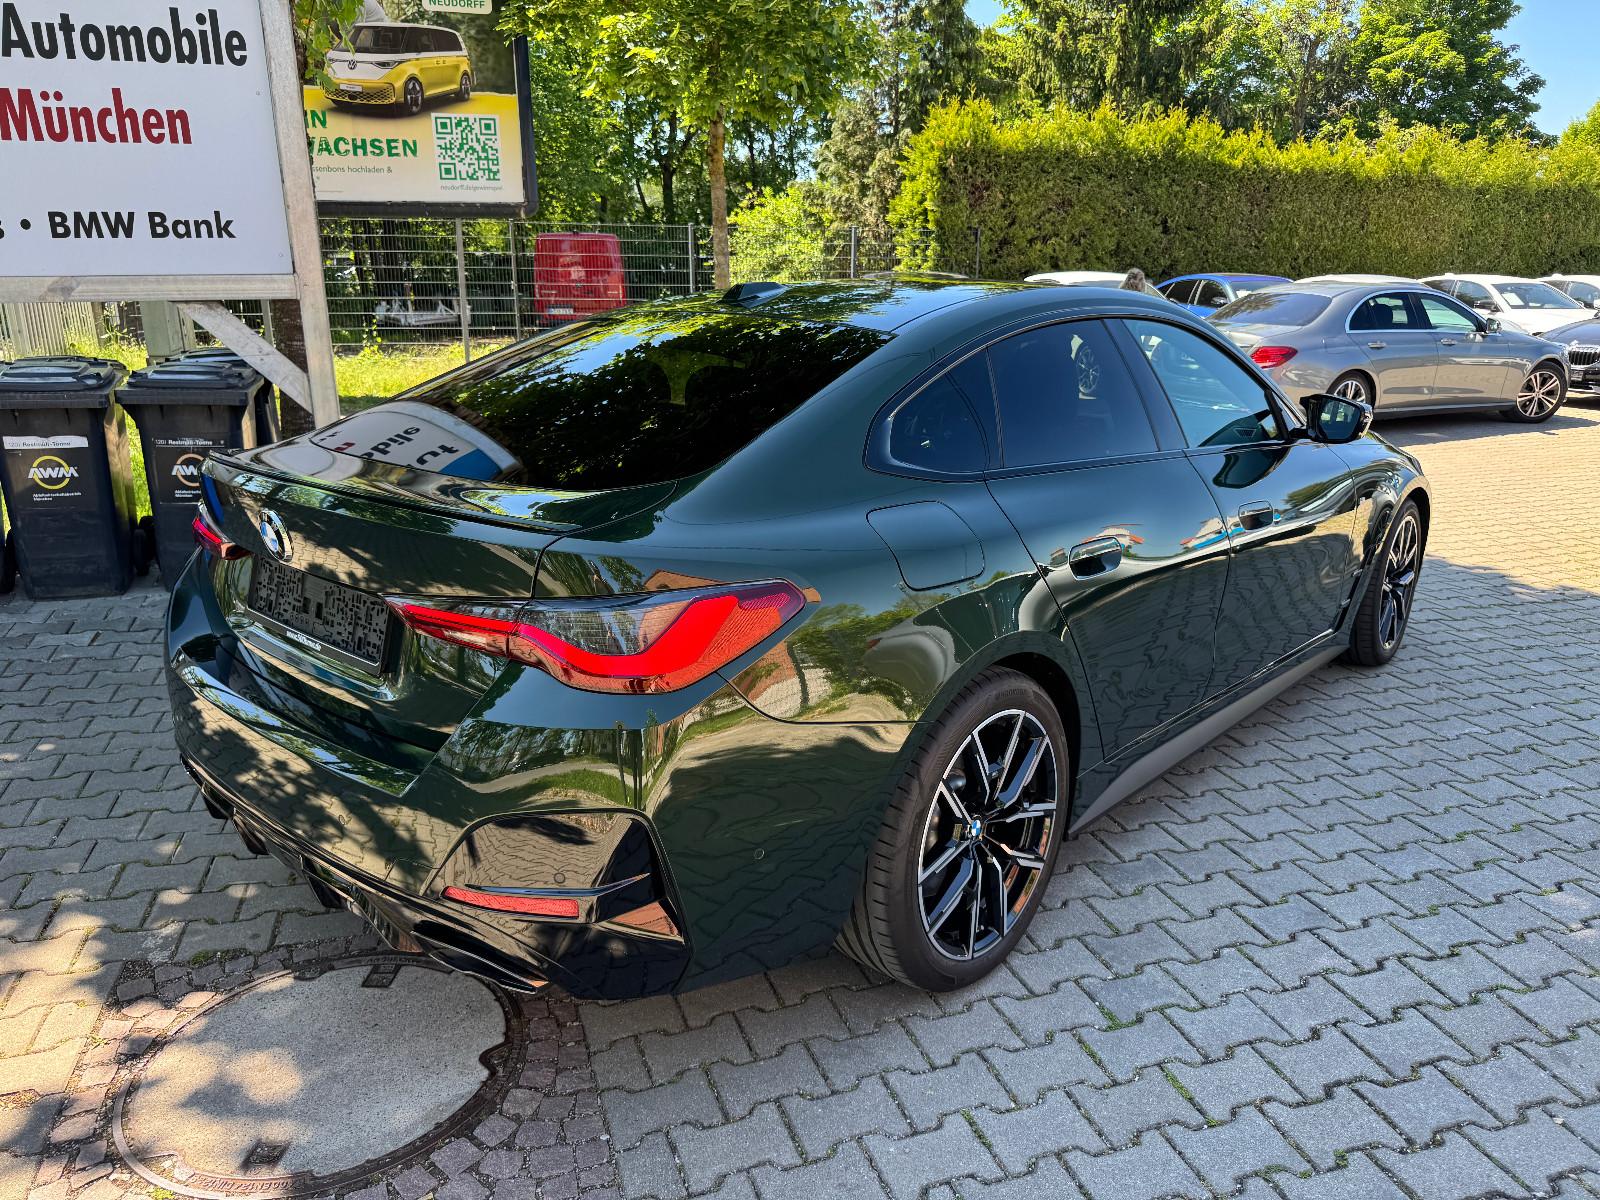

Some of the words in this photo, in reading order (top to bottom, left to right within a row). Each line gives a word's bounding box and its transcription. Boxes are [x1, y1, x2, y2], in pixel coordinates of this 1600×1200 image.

[429, 0, 485, 9] NEUDORFF
[1, 3, 248, 67] Automobile
[0, 88, 192, 144] München
[347, 166, 385, 174] hochladen
[48, 211, 135, 239] BMW
[147, 210, 236, 239] Bank
[28, 466, 79, 479] AWM
